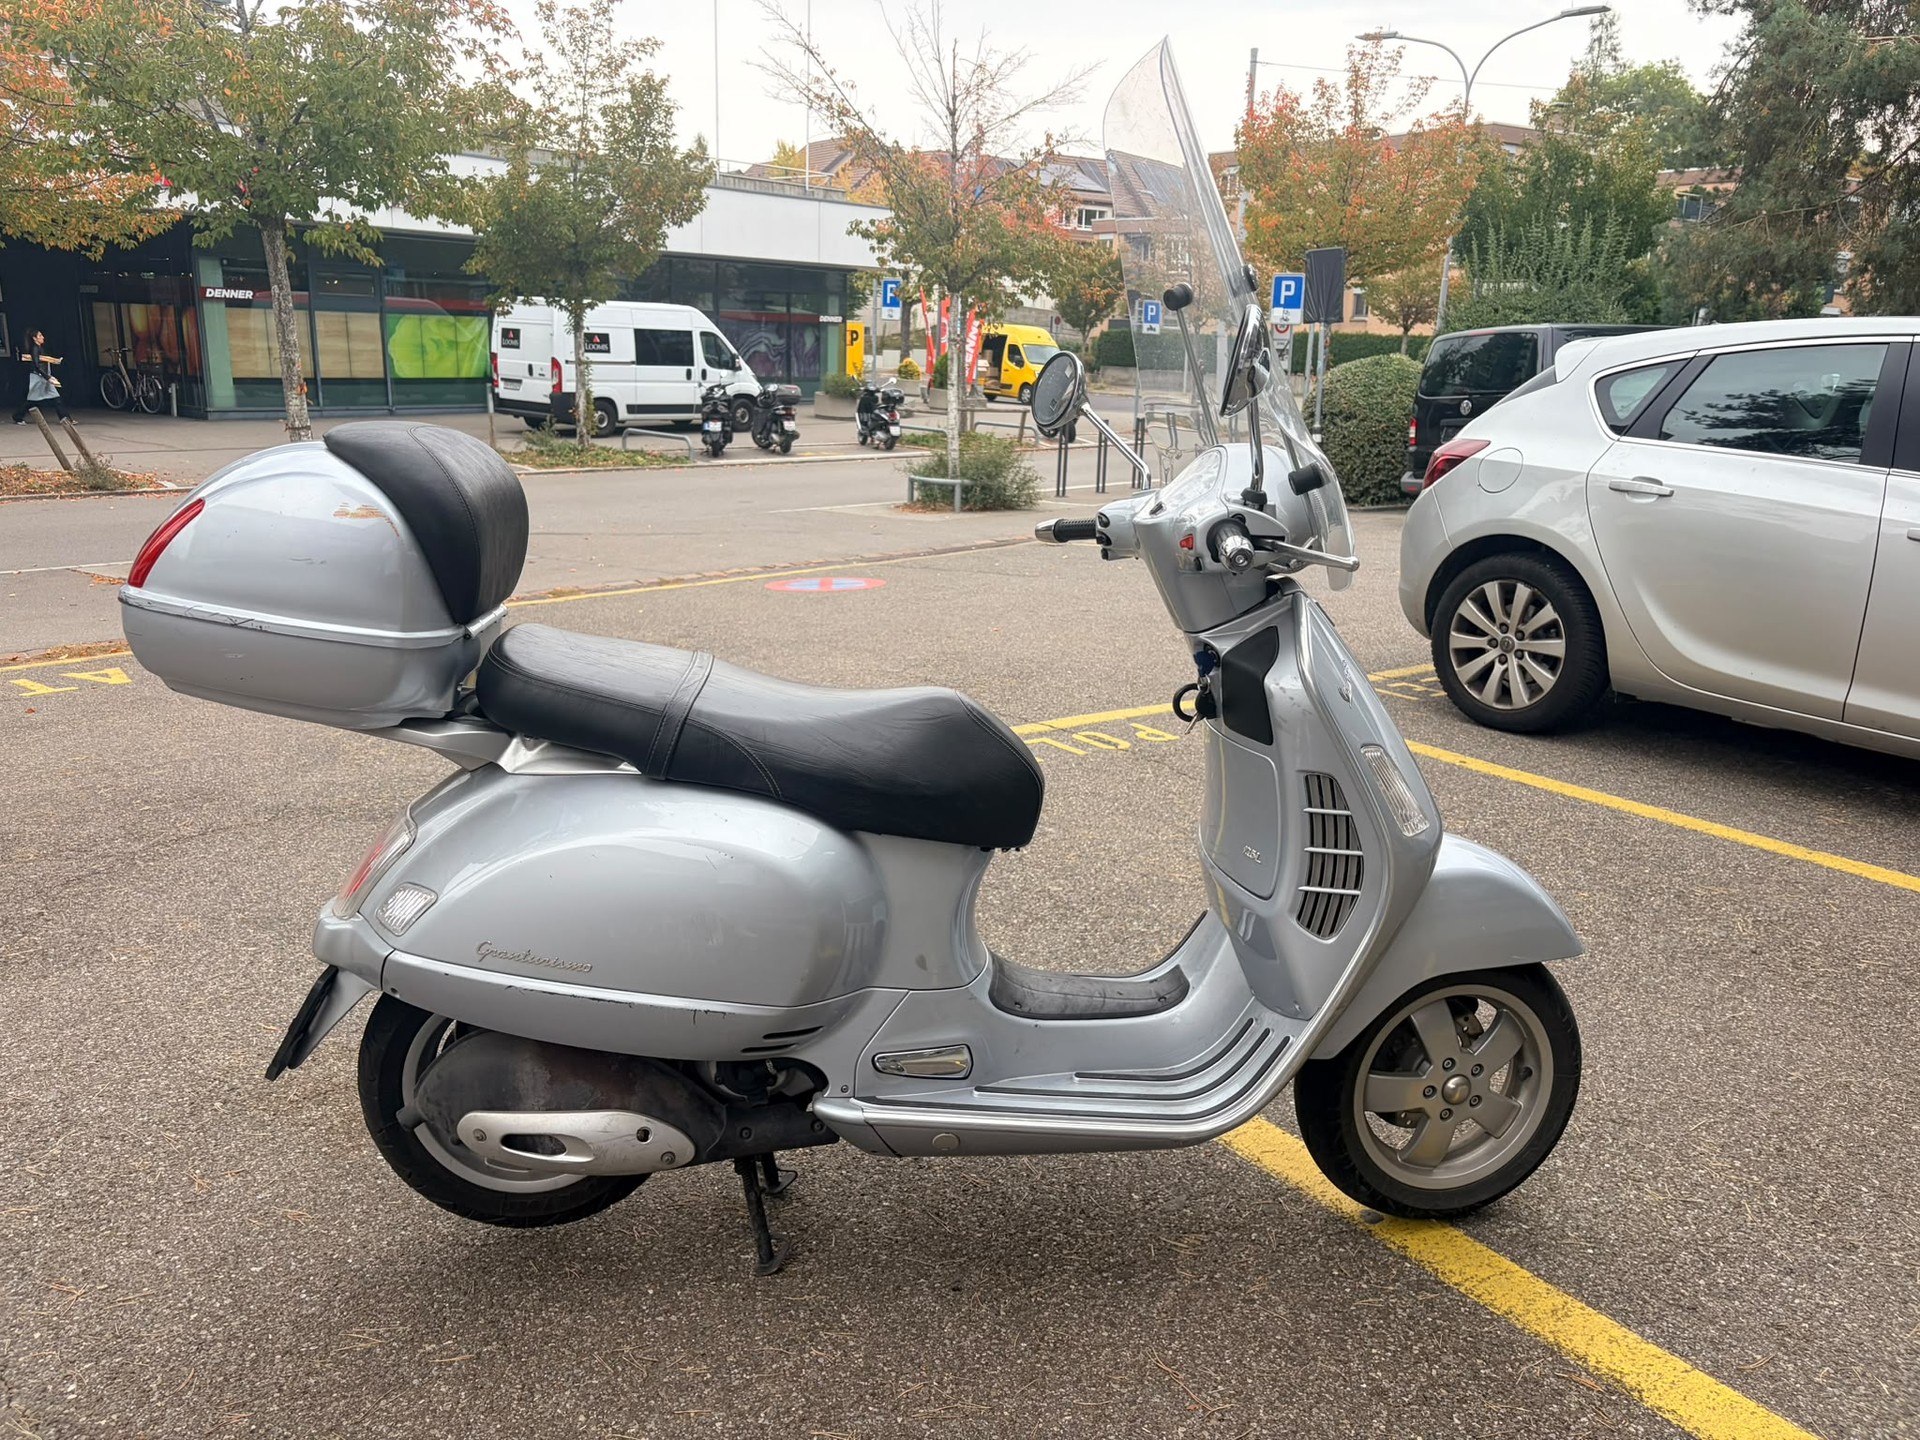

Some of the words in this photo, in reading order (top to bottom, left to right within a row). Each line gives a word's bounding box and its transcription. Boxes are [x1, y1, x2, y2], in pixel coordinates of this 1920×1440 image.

[205, 288, 254, 299] DENNER
[1280, 280, 1295, 304] P
[1147, 305, 1156, 321] P
[476, 940, 593, 973] Granturismo
